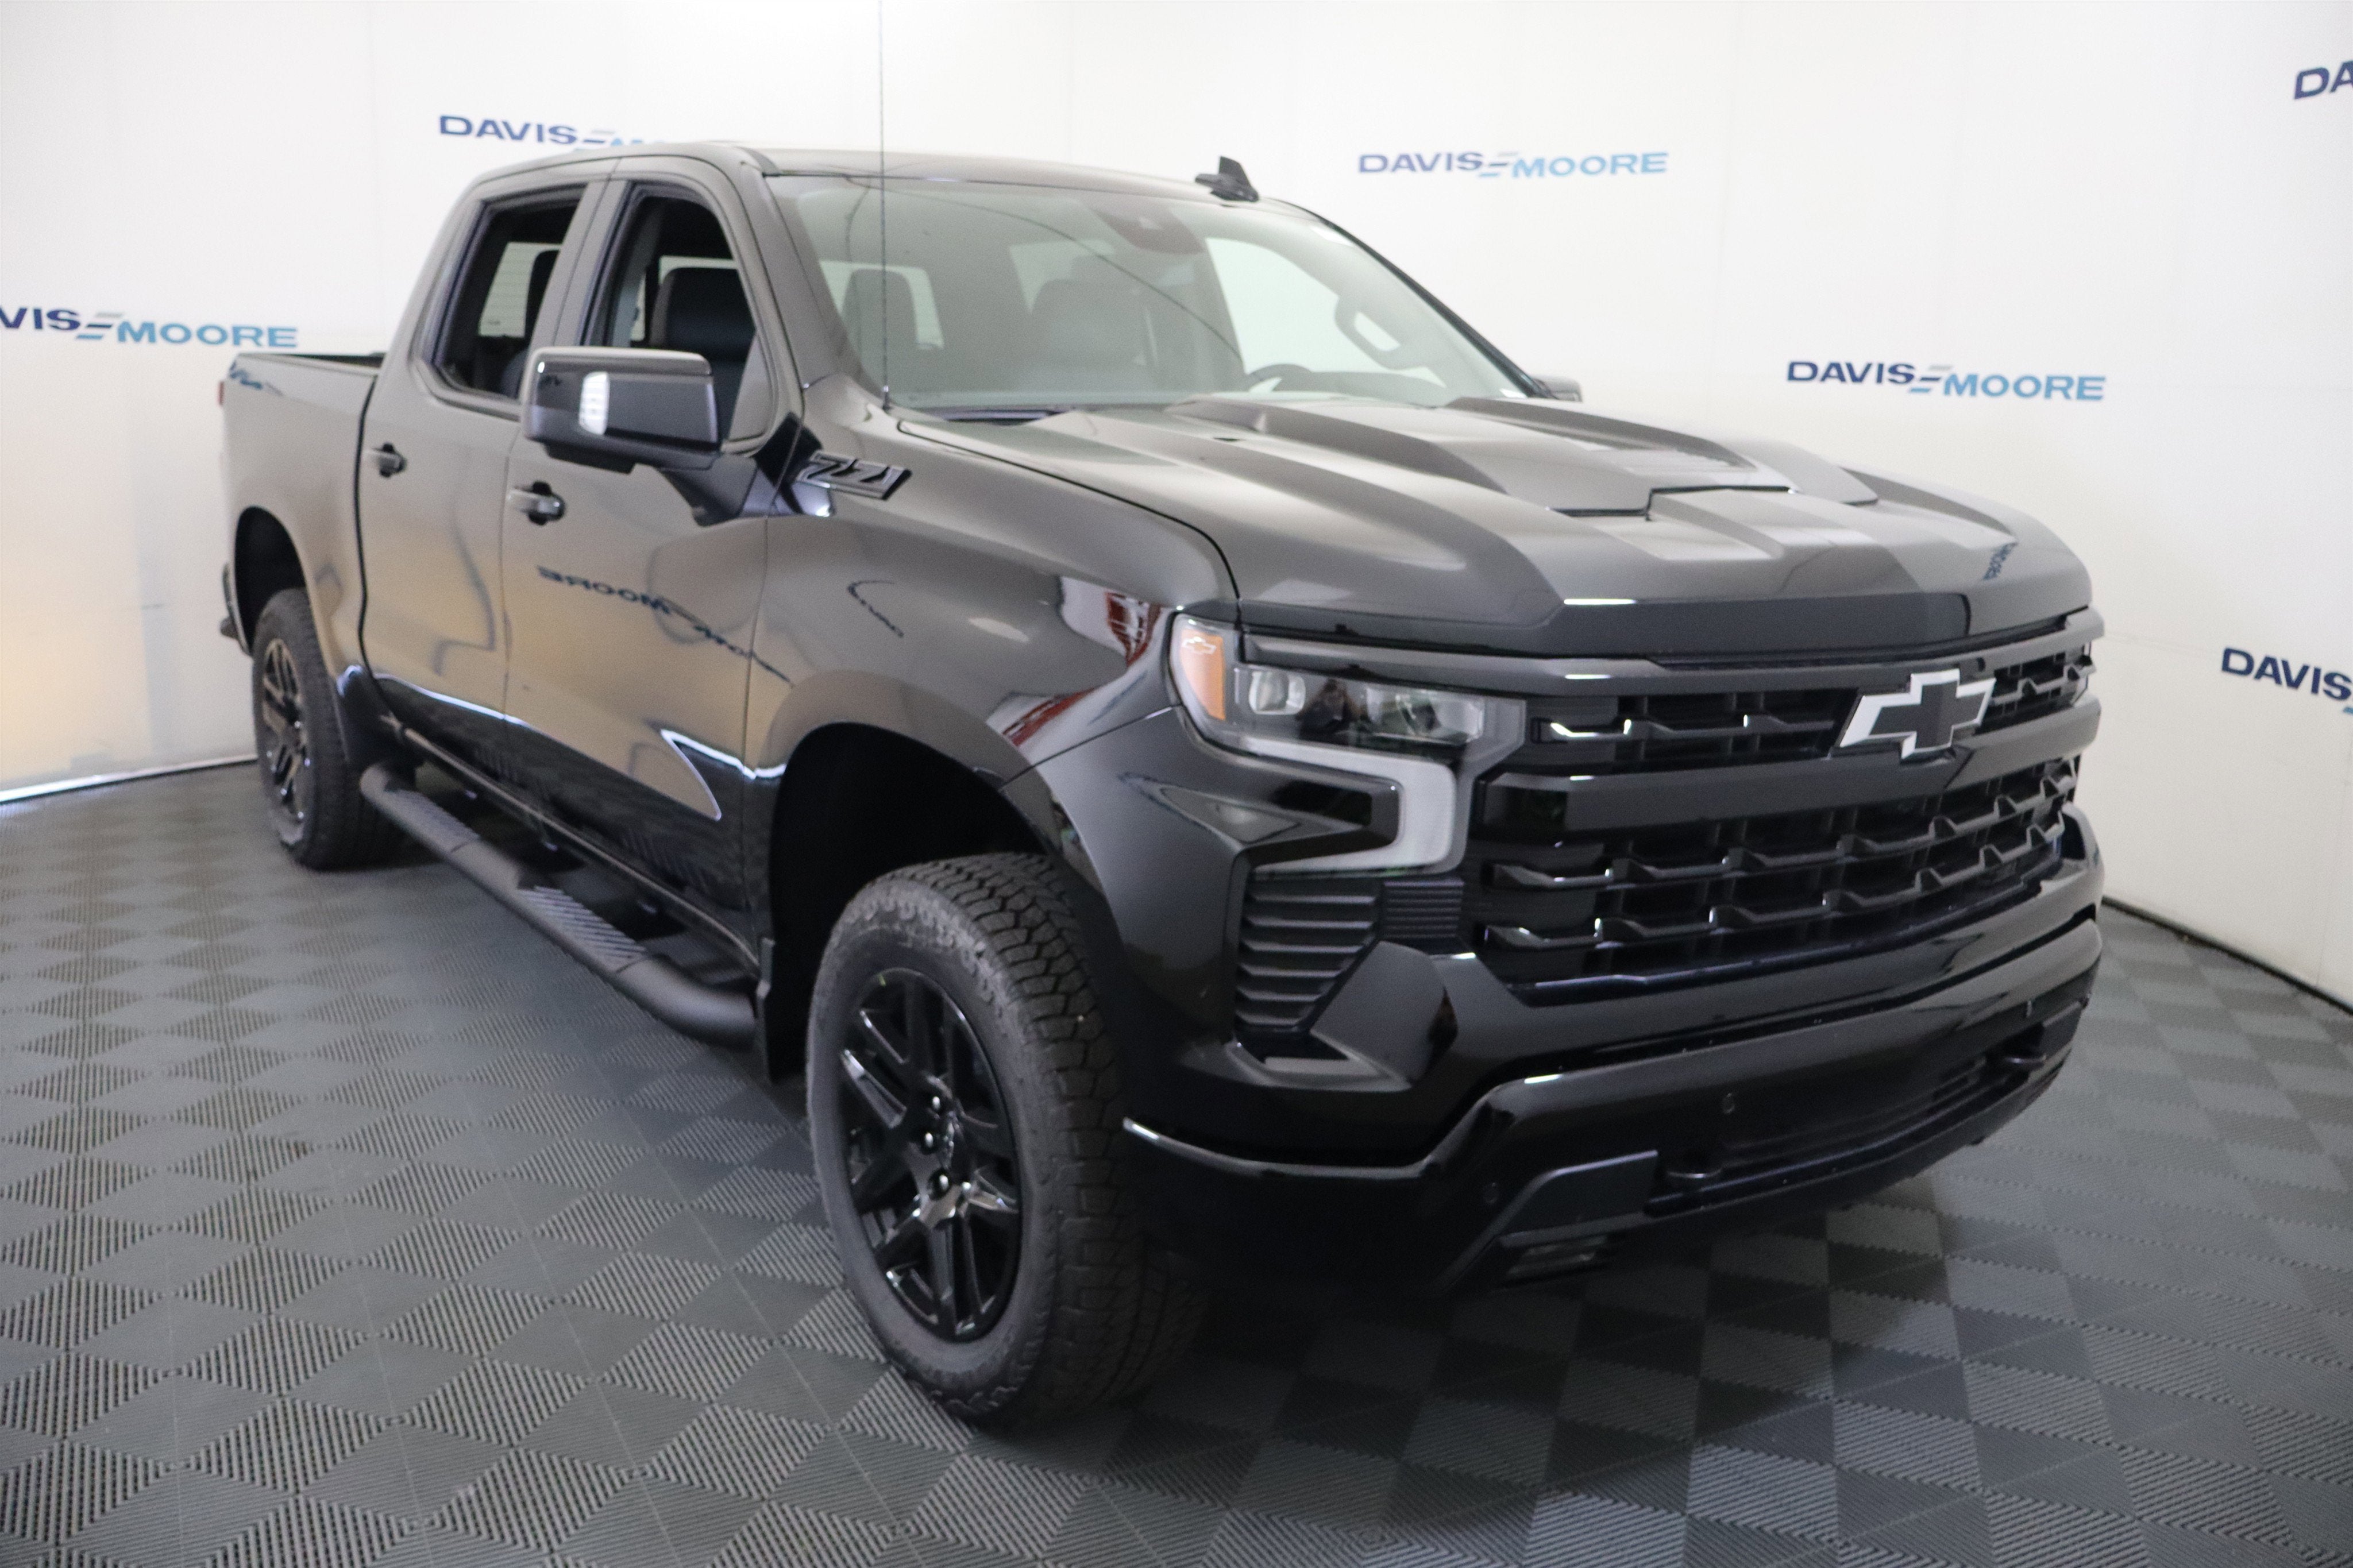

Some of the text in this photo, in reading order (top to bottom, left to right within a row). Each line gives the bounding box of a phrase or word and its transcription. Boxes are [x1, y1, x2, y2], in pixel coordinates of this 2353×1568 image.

[439, 115, 578, 145] DAVIS
[1359, 152, 1669, 178] DAVIS MOORE
[117, 320, 298, 347] MOORE
[1787, 361, 2106, 401] DAVIS MOORE
[2221, 647, 2352, 701] DAVIS
